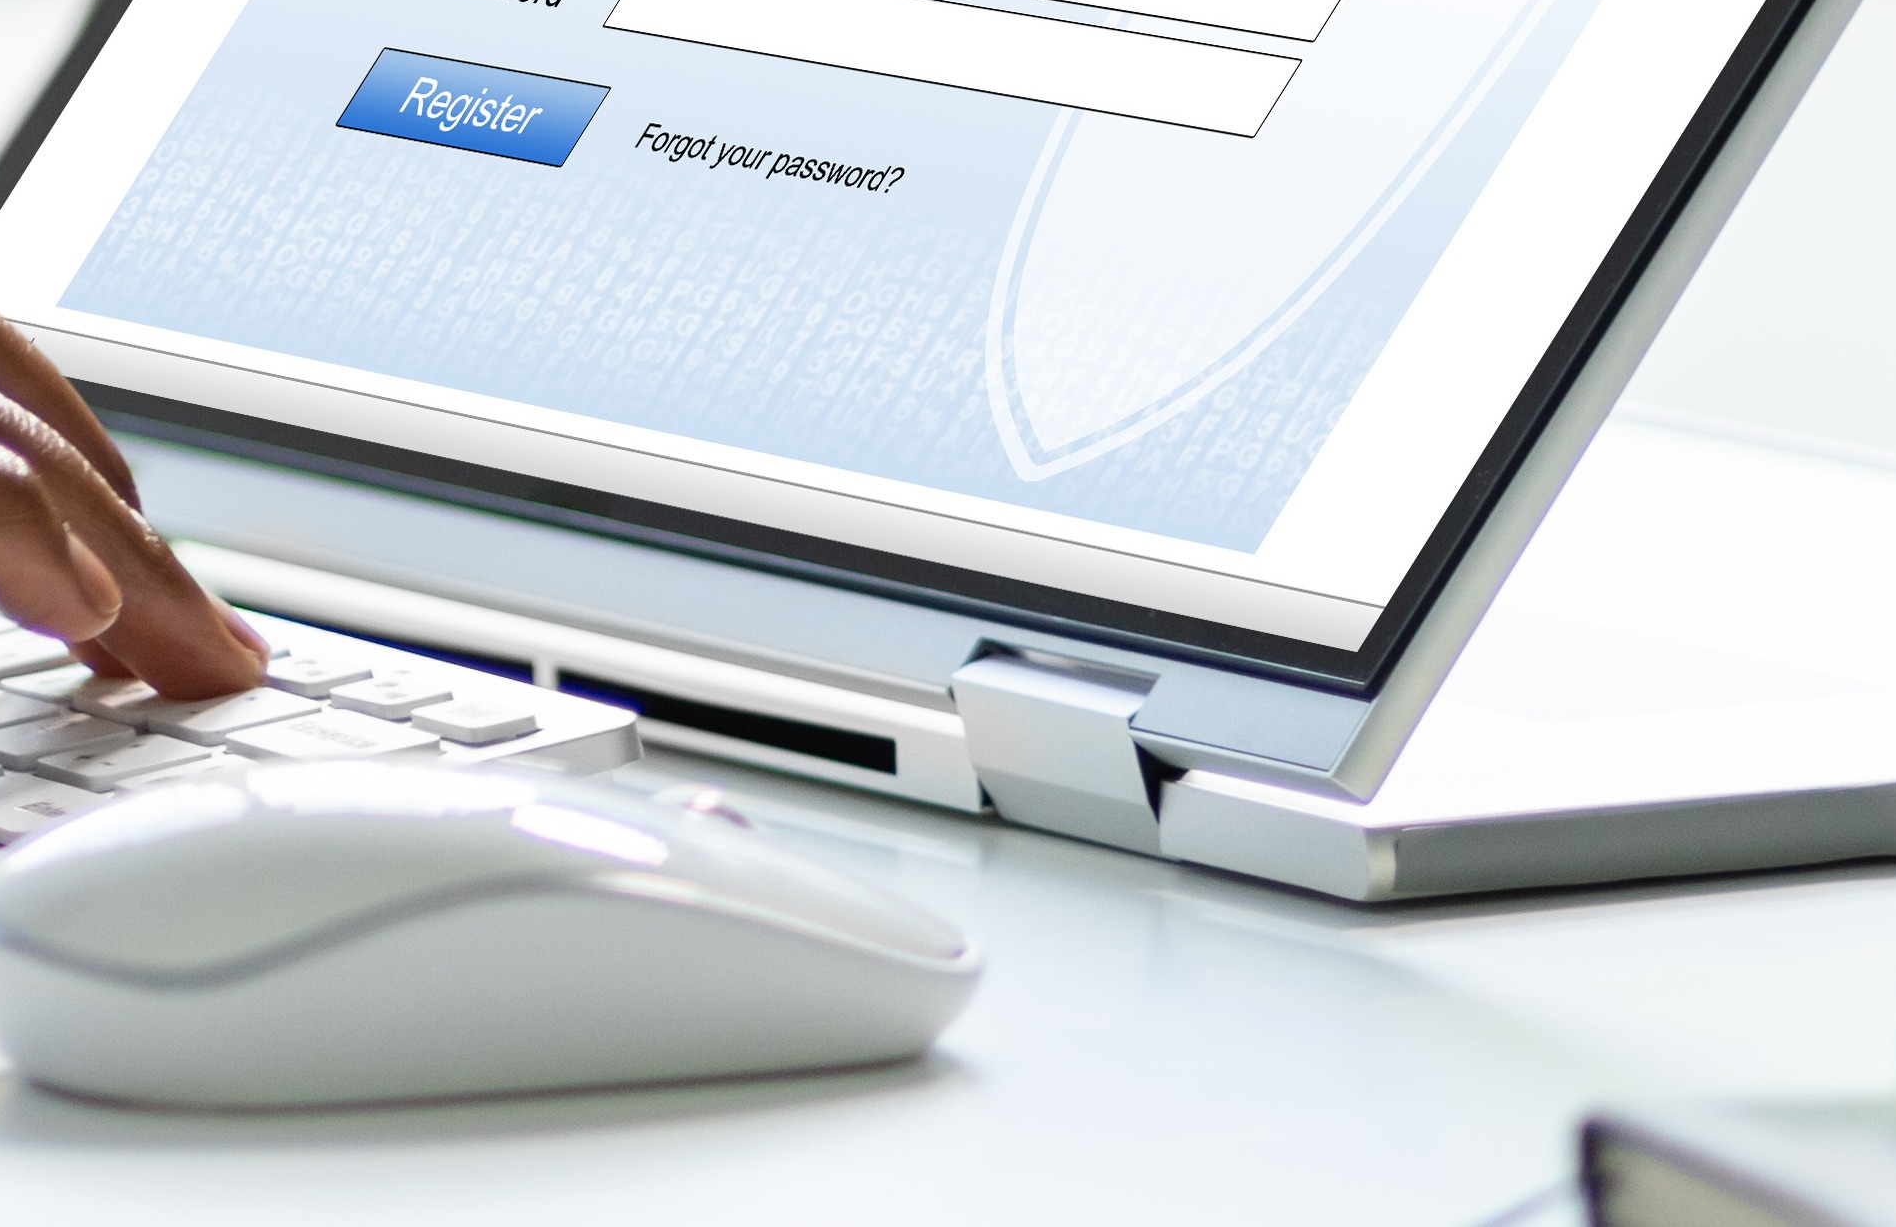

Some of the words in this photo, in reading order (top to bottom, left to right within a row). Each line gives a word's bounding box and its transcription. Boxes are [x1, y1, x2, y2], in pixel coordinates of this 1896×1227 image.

[399, 76, 545, 134] Register
[634, 122, 718, 163] Forgot
[708, 142, 773, 170] your
[765, 153, 906, 194] password?
